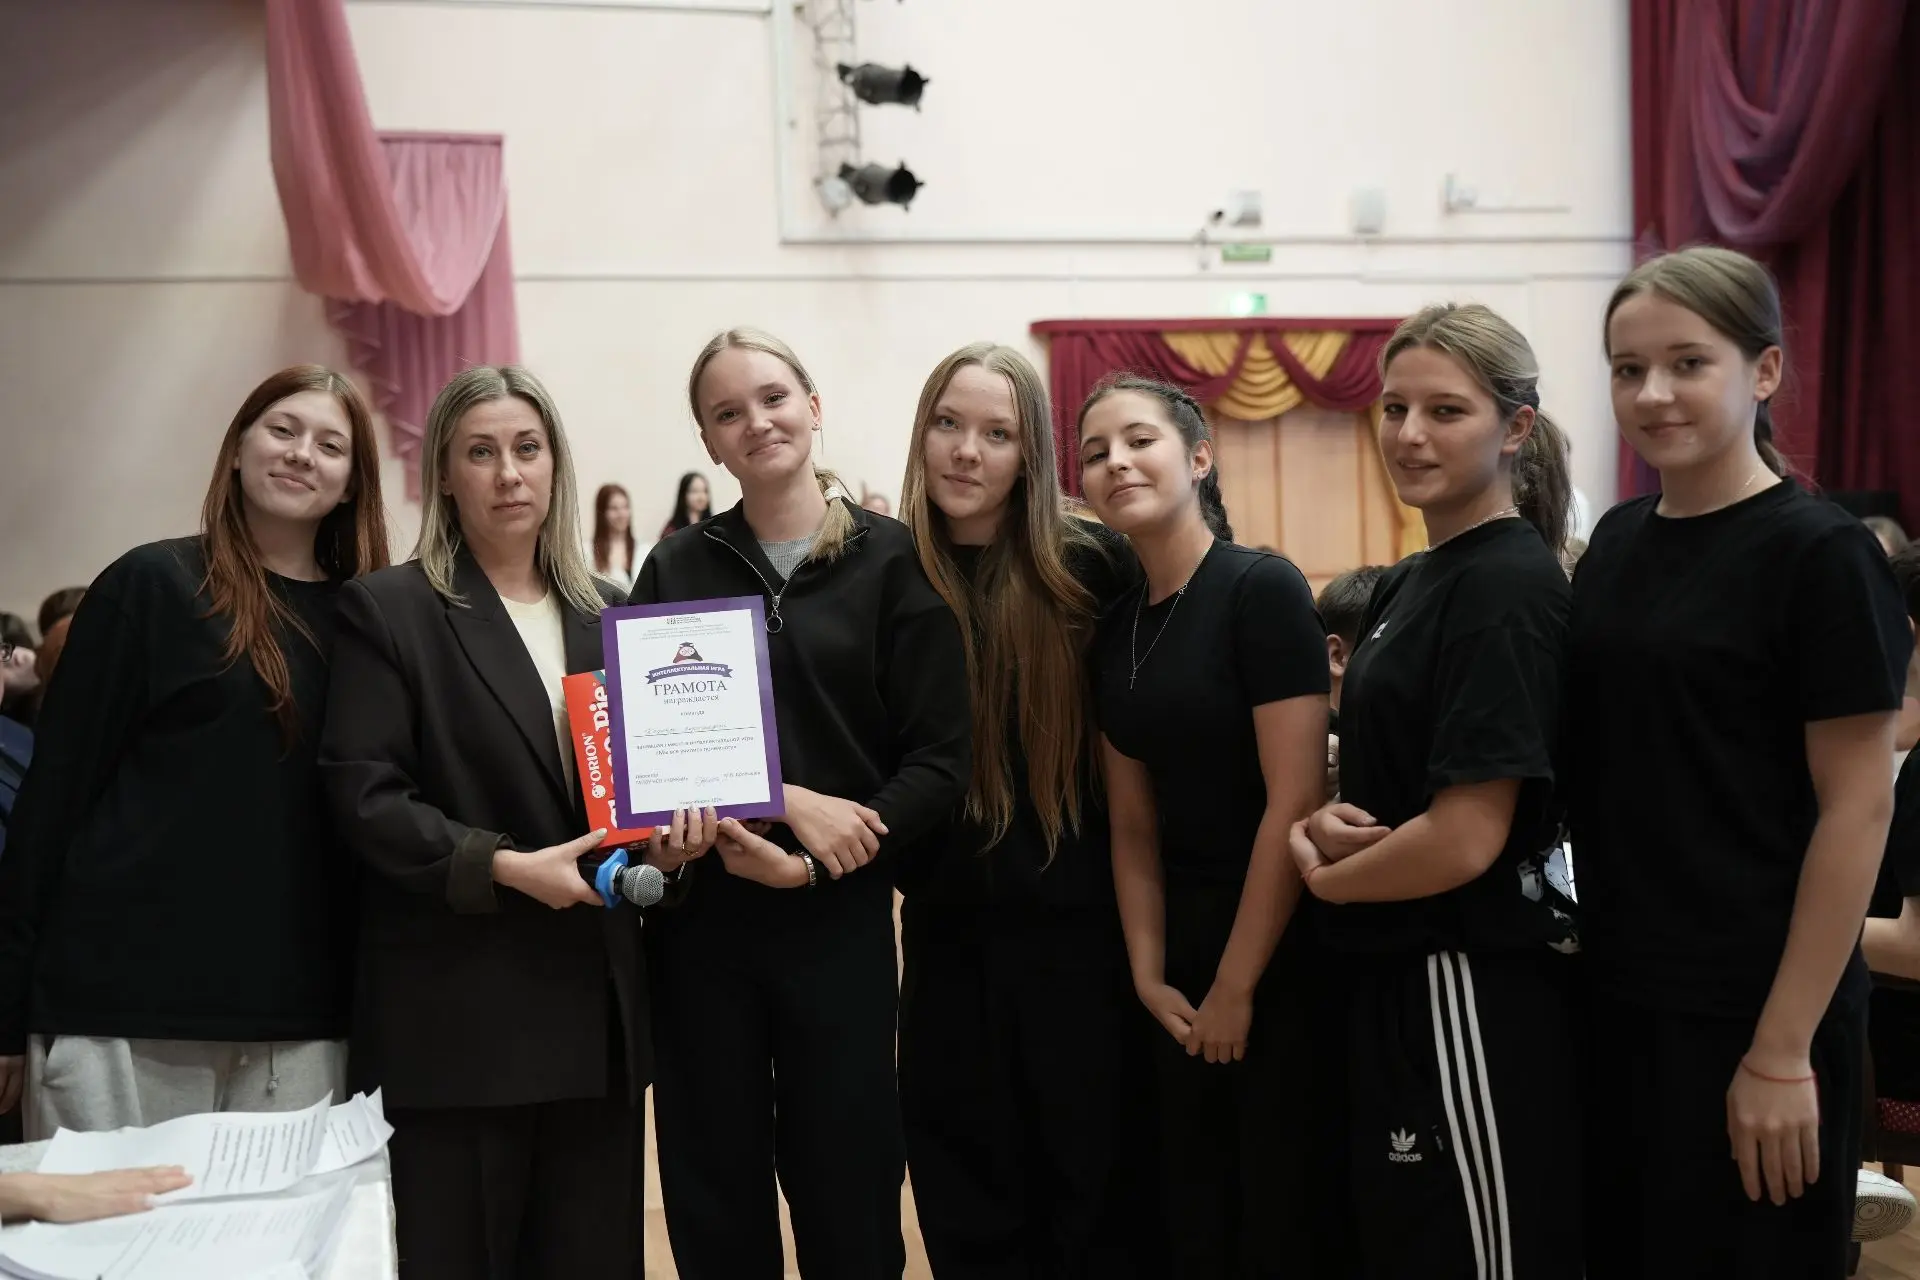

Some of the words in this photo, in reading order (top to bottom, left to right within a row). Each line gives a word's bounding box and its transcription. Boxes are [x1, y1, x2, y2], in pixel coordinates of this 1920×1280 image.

[652, 665, 710, 677] ИНТЕЛЛЕКТУАЛЬНАЯ
[653, 680, 728, 696] ГРАМОТА
[663, 695, 720, 706] награждается
[585, 734, 602, 782] ORION
[1389, 1151, 1423, 1163] adidas
